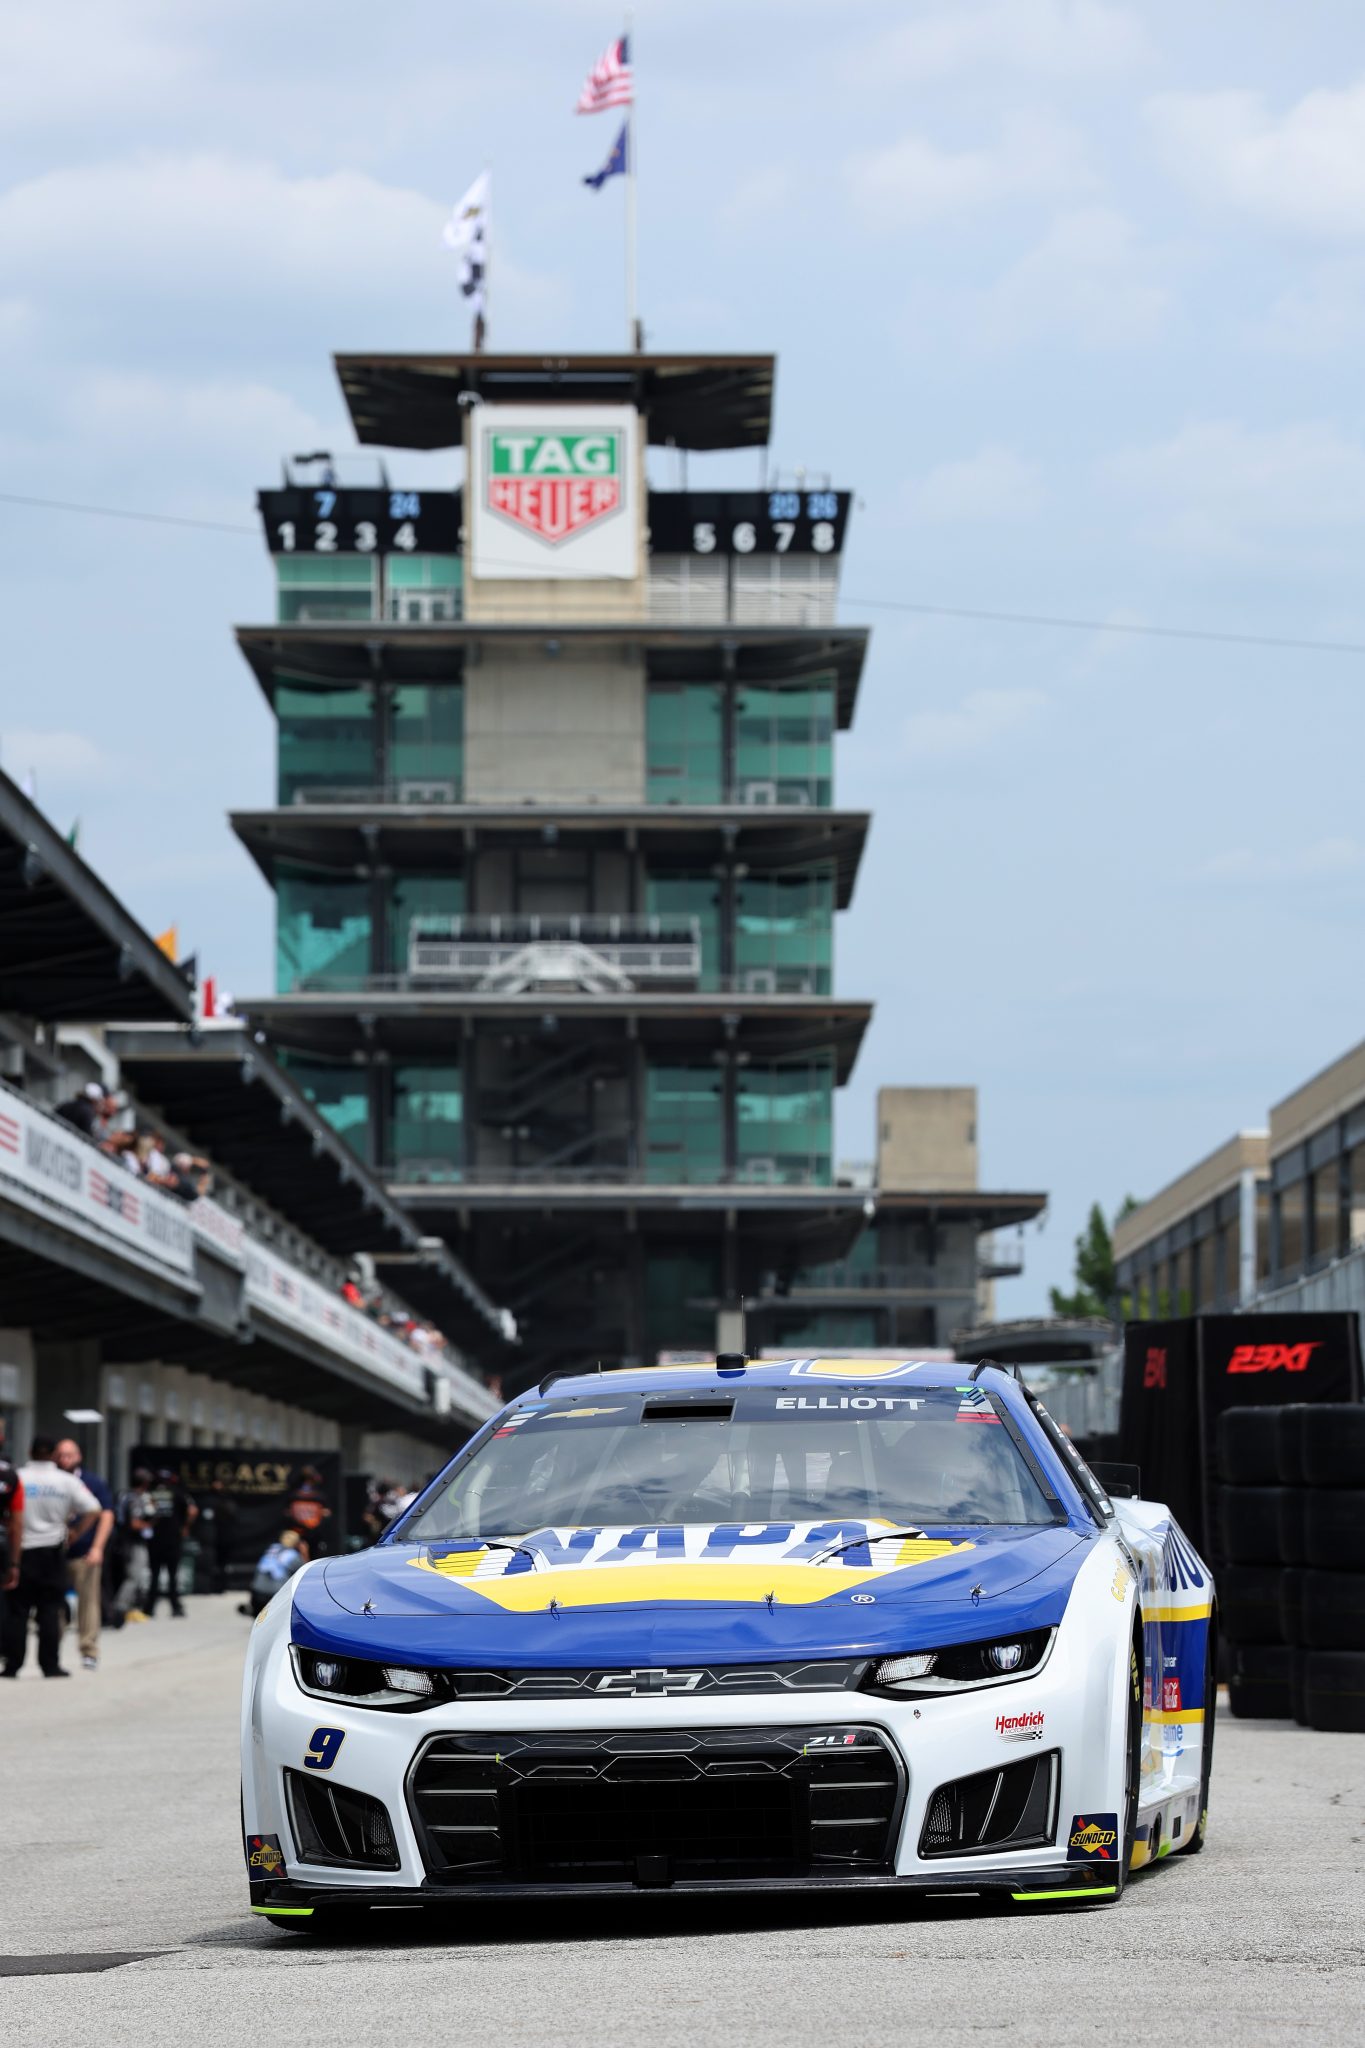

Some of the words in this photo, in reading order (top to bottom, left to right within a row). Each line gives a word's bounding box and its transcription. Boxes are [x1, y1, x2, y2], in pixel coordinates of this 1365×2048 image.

[497, 438, 610, 473] TAG
[313, 490, 337, 519] 7
[491, 480, 618, 534] HEUER
[278, 521, 296, 551] 1
[315, 521, 338, 551] 2
[355, 521, 377, 551] 3
[393, 522, 418, 551] 4
[693, 522, 716, 553] 5
[732, 522, 756, 553] 6
[772, 522, 796, 552] 7
[812, 522, 835, 553] 8
[775, 1397, 926, 1411] ELLIOTT
[181, 1461, 291, 1484] LEGACY
[503, 1521, 873, 1575] NAPA
[995, 1711, 1045, 1734] Hendrick
[303, 1726, 346, 1771] 9
[805, 1734, 857, 1747] ZL1
[1071, 1832, 1114, 1845] SUNOCO
[252, 1852, 280, 1865] SUNOCO
